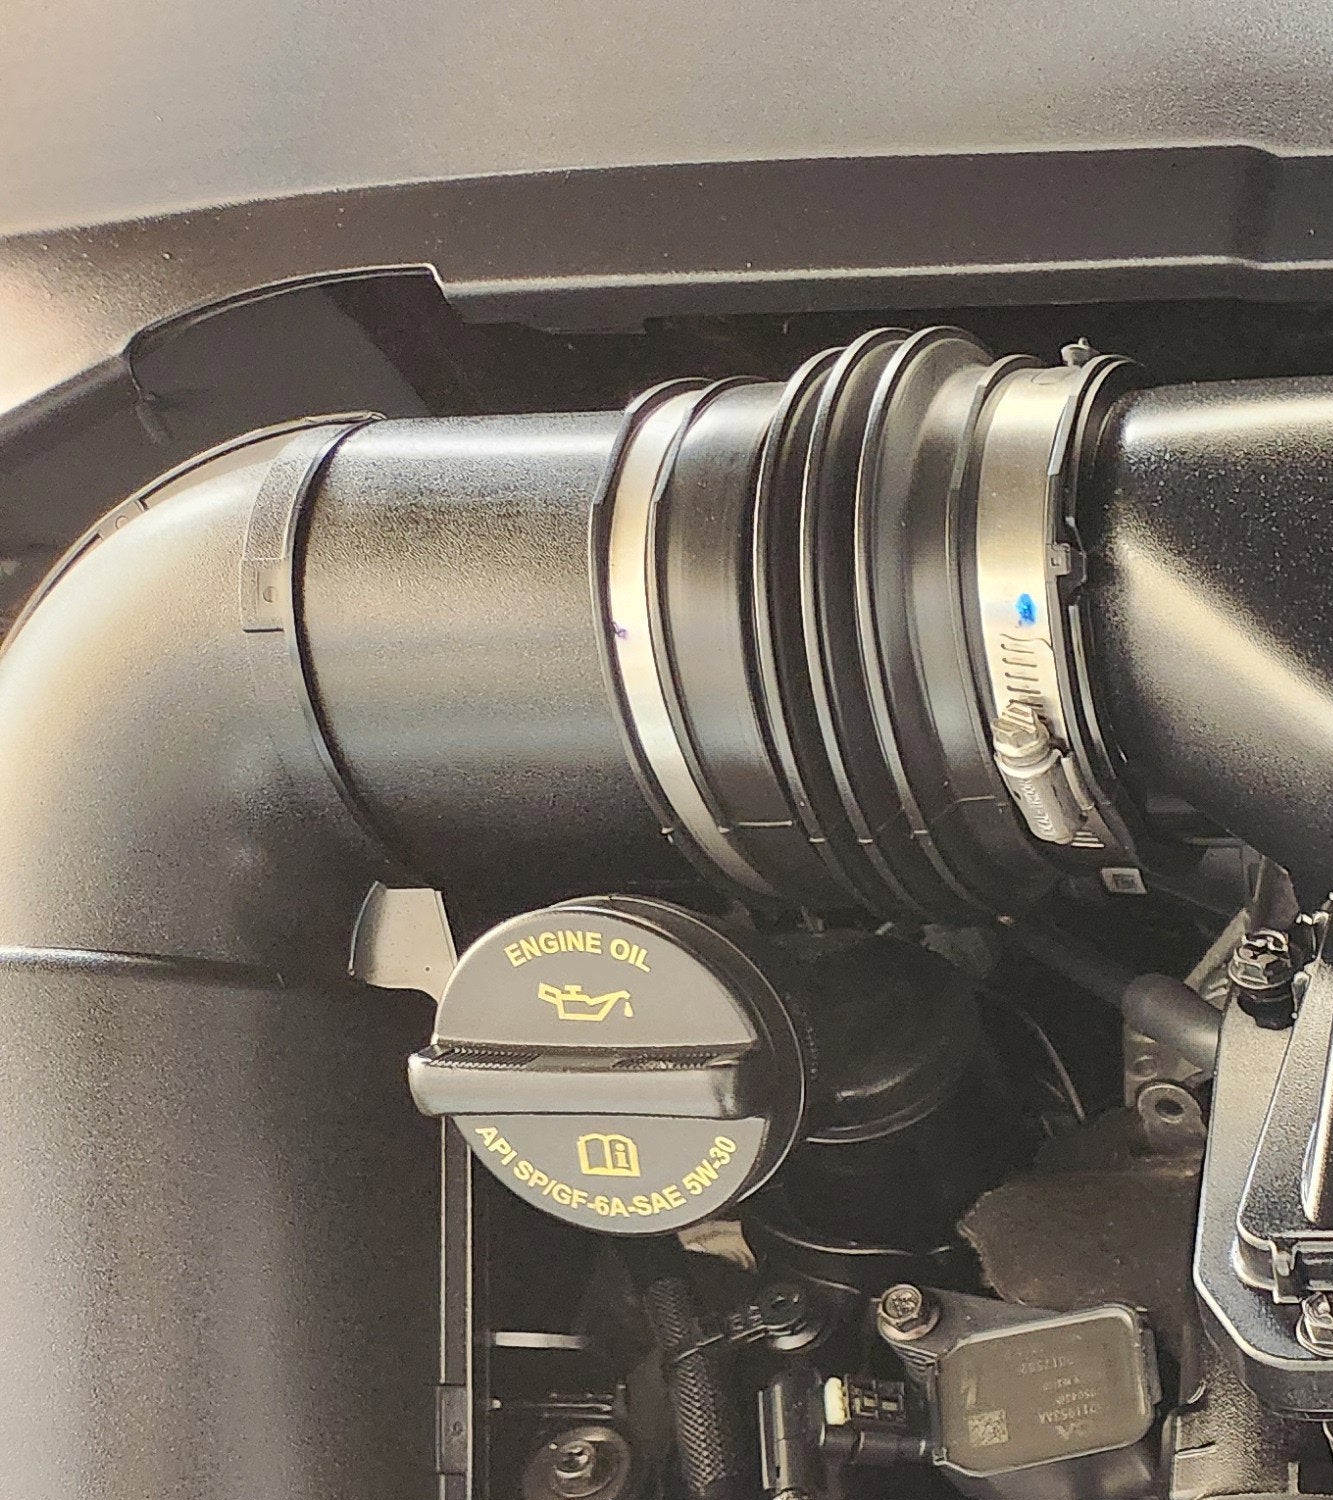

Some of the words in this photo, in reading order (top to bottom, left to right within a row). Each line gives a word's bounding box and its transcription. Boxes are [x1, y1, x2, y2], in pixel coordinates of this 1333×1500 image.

[503, 929, 602, 968] ENGINE
[610, 937, 652, 973] OIL
[474, 1124, 517, 1167] API
[682, 1134, 738, 1197] 5W-30
